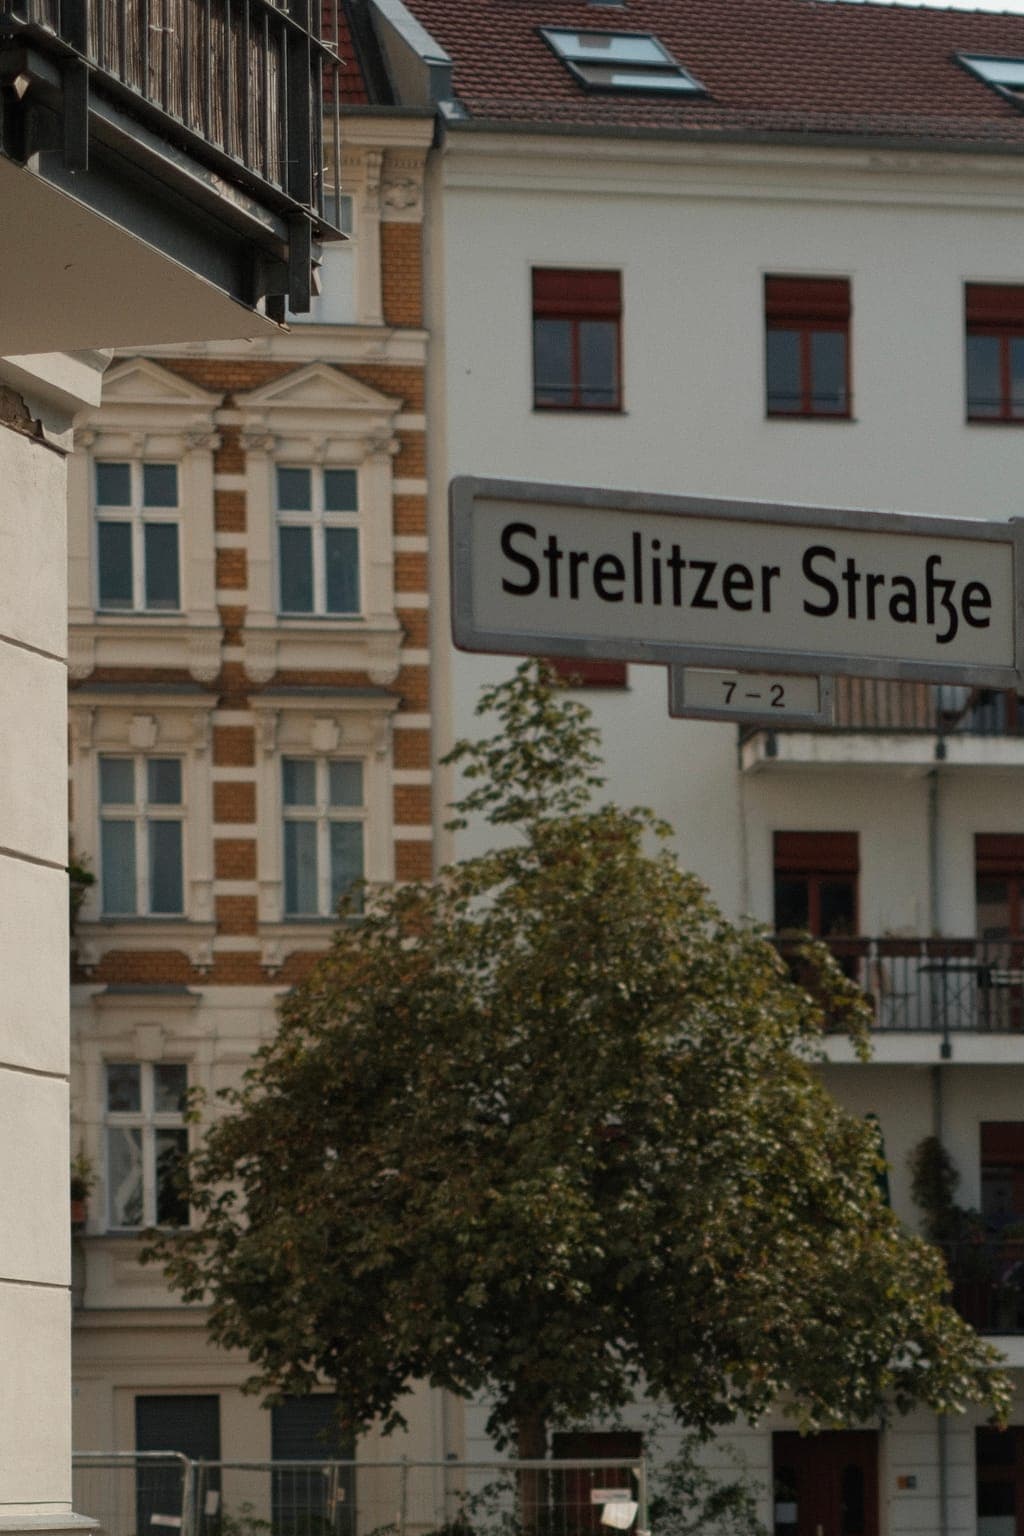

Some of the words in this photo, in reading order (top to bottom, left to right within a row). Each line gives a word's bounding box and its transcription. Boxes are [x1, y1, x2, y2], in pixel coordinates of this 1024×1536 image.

[500, 522, 781, 613] Strelitzer
[802, 545, 992, 644] Straße
[721, 681, 737, 705] 7
[770, 684, 785, 708] 2
